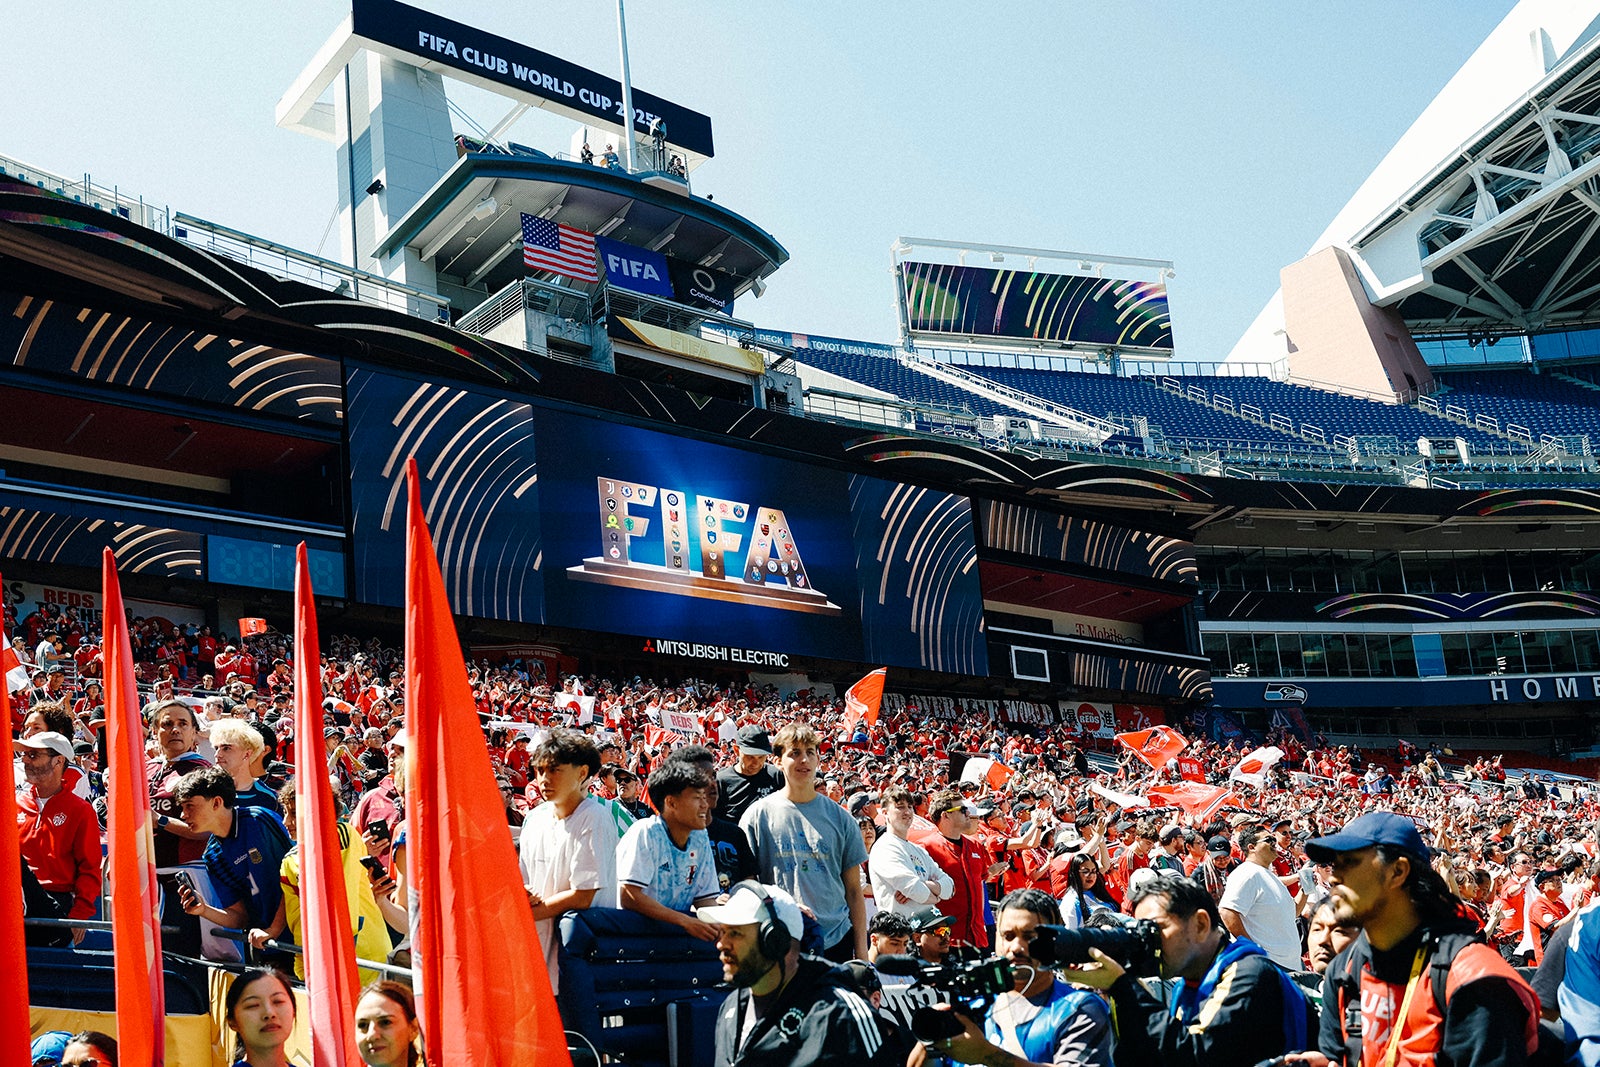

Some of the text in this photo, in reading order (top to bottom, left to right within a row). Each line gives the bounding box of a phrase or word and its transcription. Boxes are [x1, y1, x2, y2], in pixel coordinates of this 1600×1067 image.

[418, 30, 458, 59] FIFA
[462, 46, 509, 75] CLUB
[512, 62, 576, 98] WORLD
[579, 88, 612, 111] CUP
[607, 253, 661, 281] FIFA
[689, 288, 726, 308] Concacaf
[811, 340, 890, 358] TOYOTA FAN DECK
[1009, 420, 1028, 429] 24
[597, 476, 813, 591] FIFA
[43, 588, 95, 609] REDS
[656, 640, 789, 668] MITSUBISHI ELECTRIC
[670, 714, 693, 729] REDS
[1080, 715, 1100, 724] REDS
